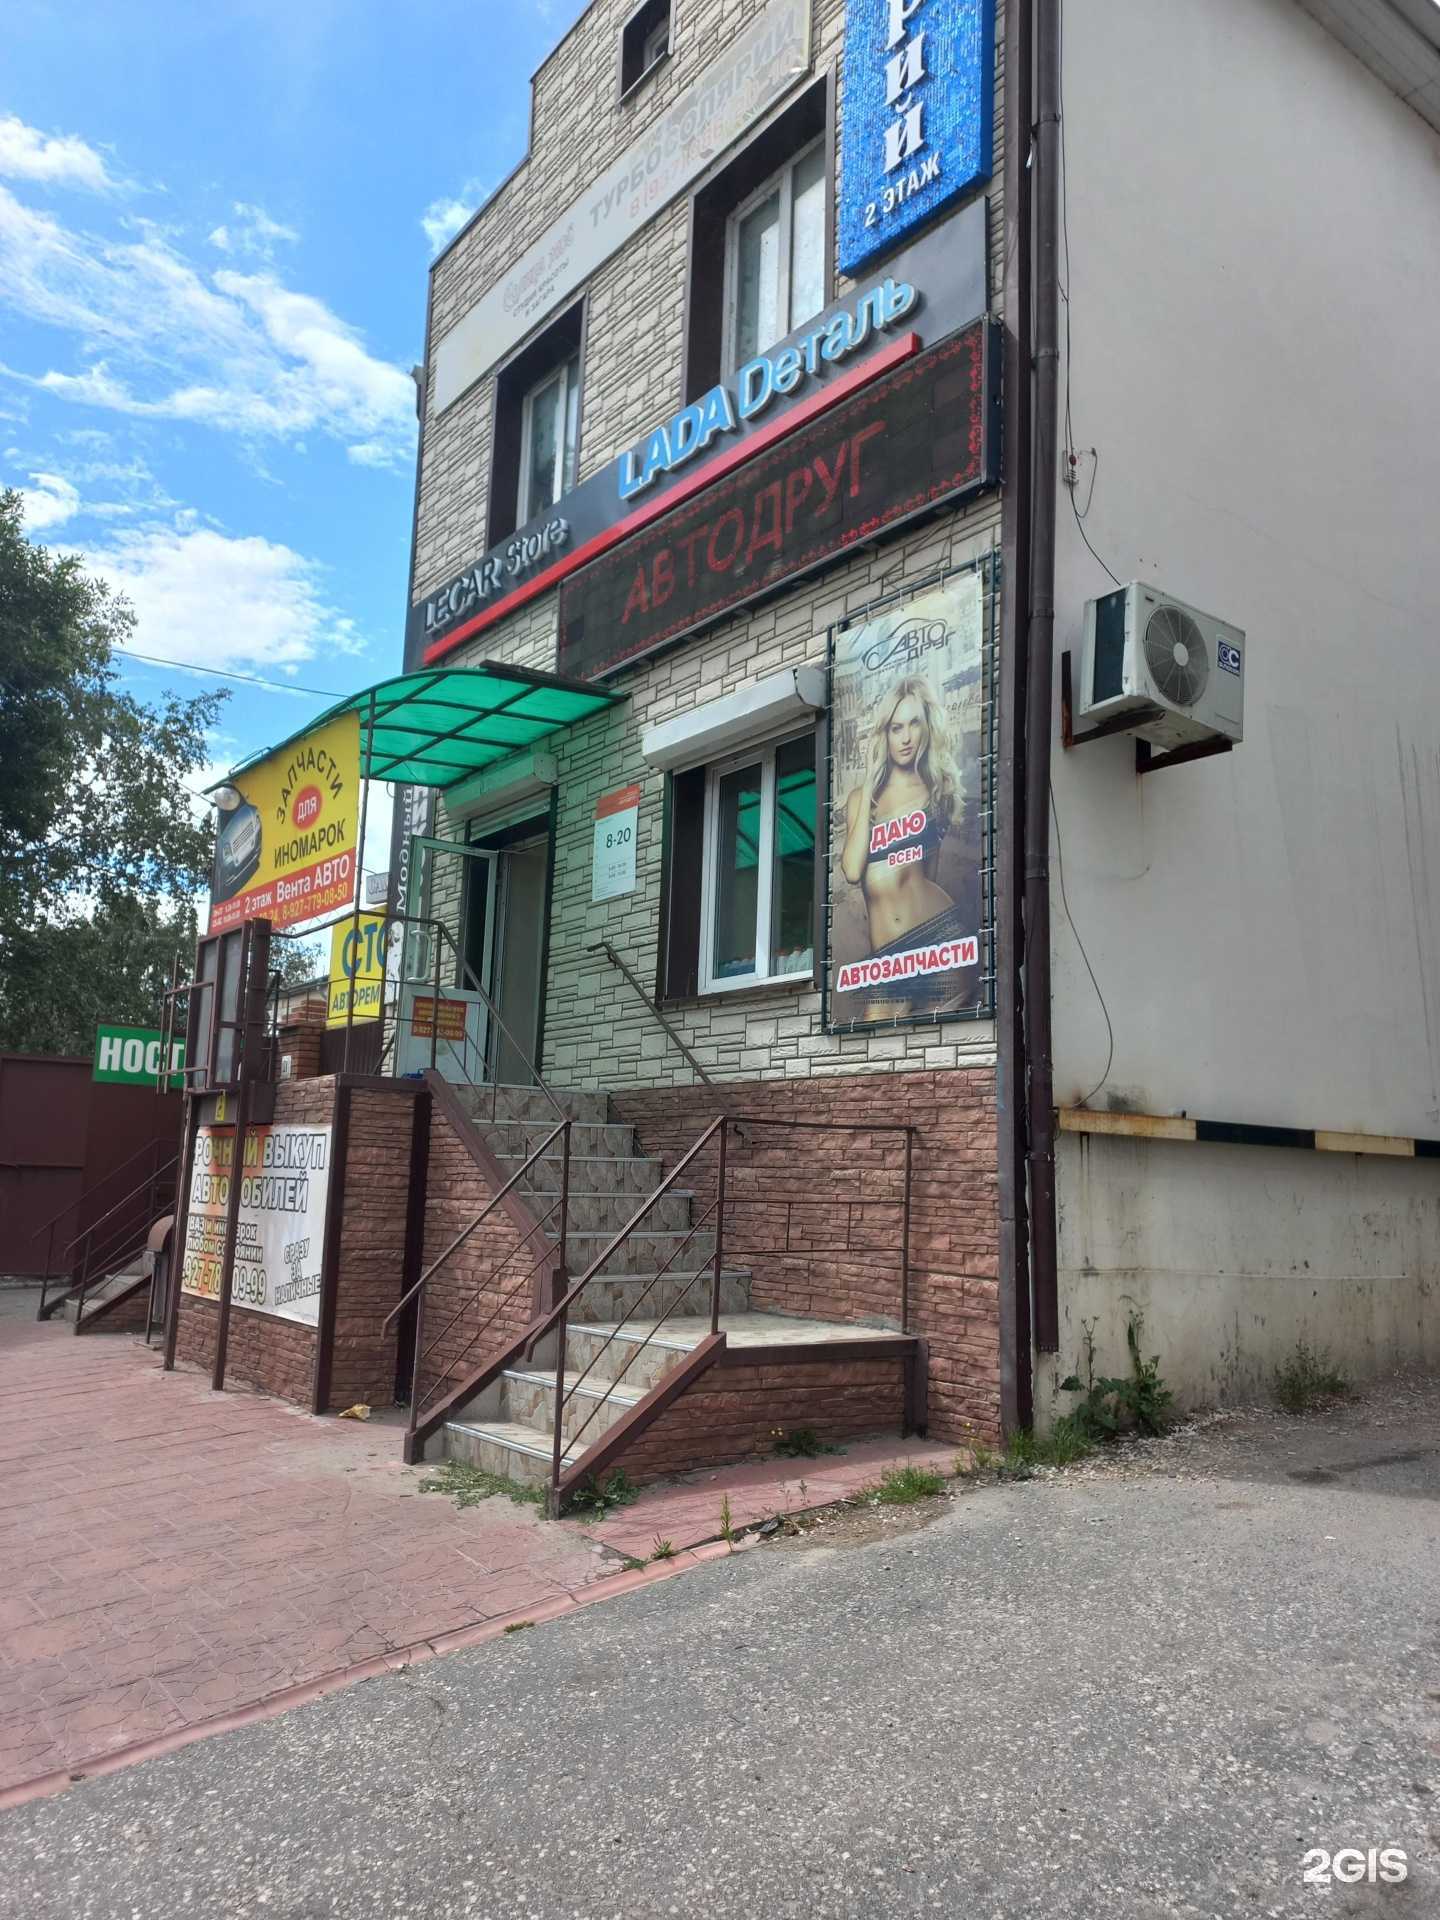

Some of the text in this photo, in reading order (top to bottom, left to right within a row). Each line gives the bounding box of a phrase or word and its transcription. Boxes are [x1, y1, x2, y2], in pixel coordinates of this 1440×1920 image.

[864, 152, 940, 227] 2 ЭТАЖ
[618, 384, 736, 500] LADA
[621, 420, 887, 625] АВТОДРУГ
[425, 518, 570, 634] LECAR Store
[277, 747, 344, 825] ЗАПЧАСТИ
[297, 796, 317, 824] ДЛЯ
[274, 818, 346, 868] ИНОМАРОК
[606, 827, 631, 848] 8-20
[871, 811, 926, 852] ДАЮ
[889, 847, 922, 866] ВСЕМ
[244, 896, 251, 914] 2
[277, 876, 311, 904] Вента
[314, 854, 350, 890] АВТО
[839, 939, 976, 990] АВТОЗАПЧАСТИ
[262, 1133, 327, 1170] ВЫКУП
[191, 1171, 310, 1213] АВТООБИЛЕЙ
